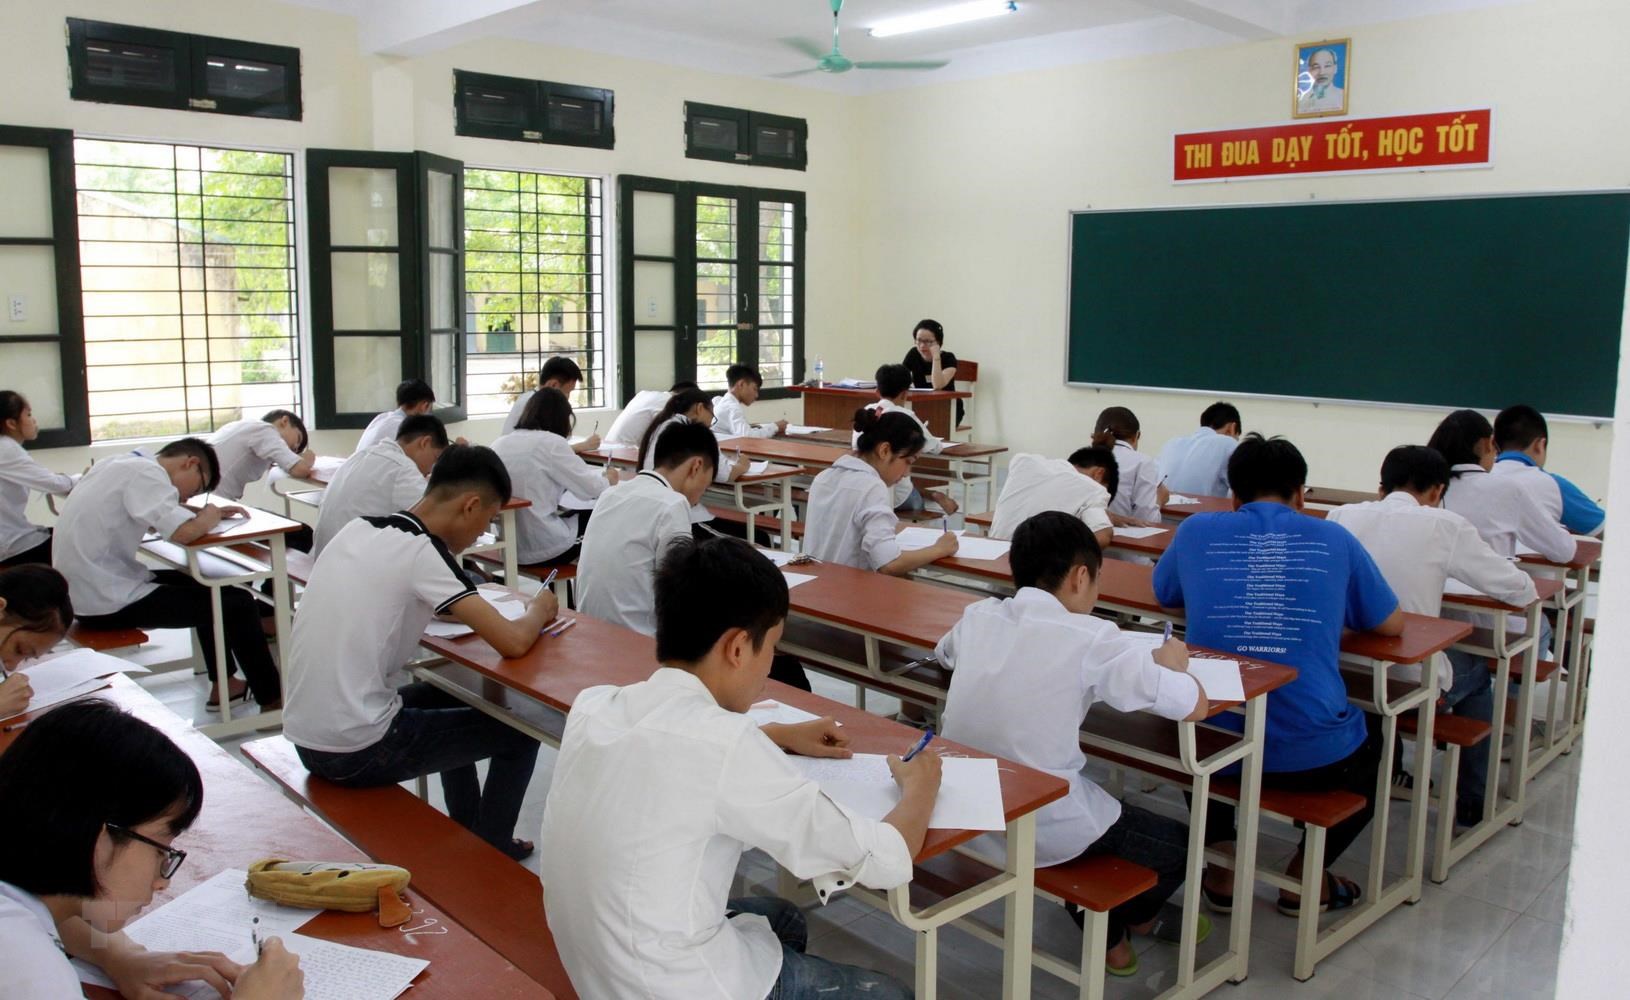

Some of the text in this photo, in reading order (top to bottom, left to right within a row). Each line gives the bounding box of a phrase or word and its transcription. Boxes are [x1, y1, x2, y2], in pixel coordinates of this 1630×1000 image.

[1184, 114, 1480, 169] THI ĐUA DẠY TỐT, HỌC TỐT
[1248, 645, 1287, 654] WARRIORS!
